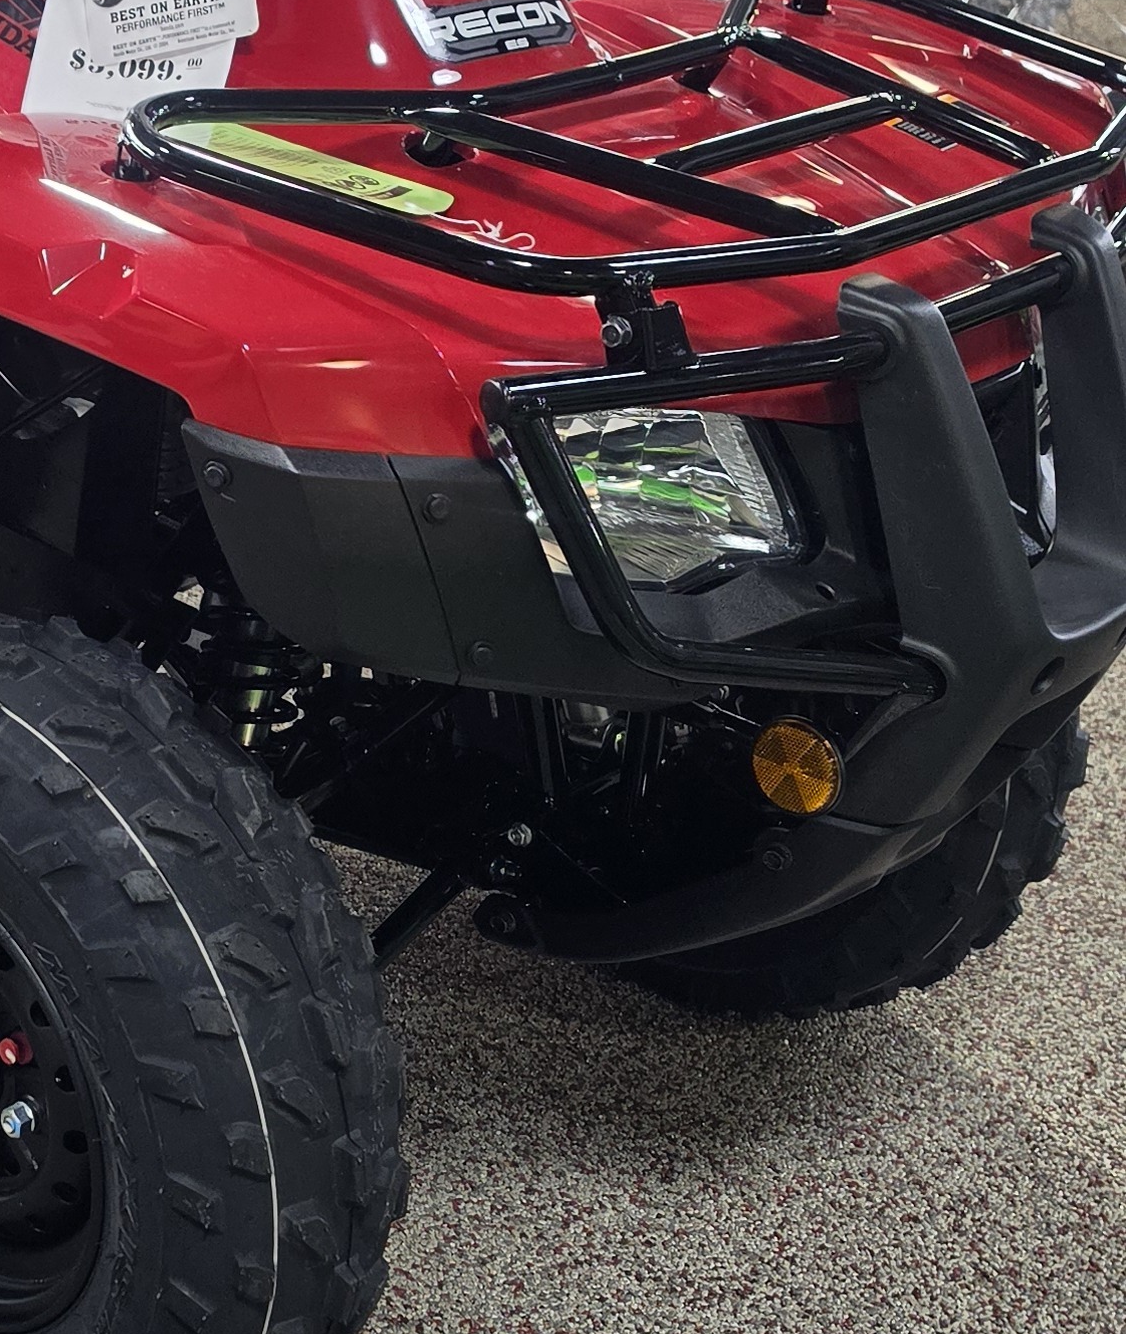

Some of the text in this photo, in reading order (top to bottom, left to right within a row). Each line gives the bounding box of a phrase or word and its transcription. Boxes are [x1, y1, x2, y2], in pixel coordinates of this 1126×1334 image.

[110, 6, 146, 24] BEST
[150, 0, 169, 15] ON
[115, 11, 186, 35] PERFORMANCE
[425, 0, 572, 47] RECON
